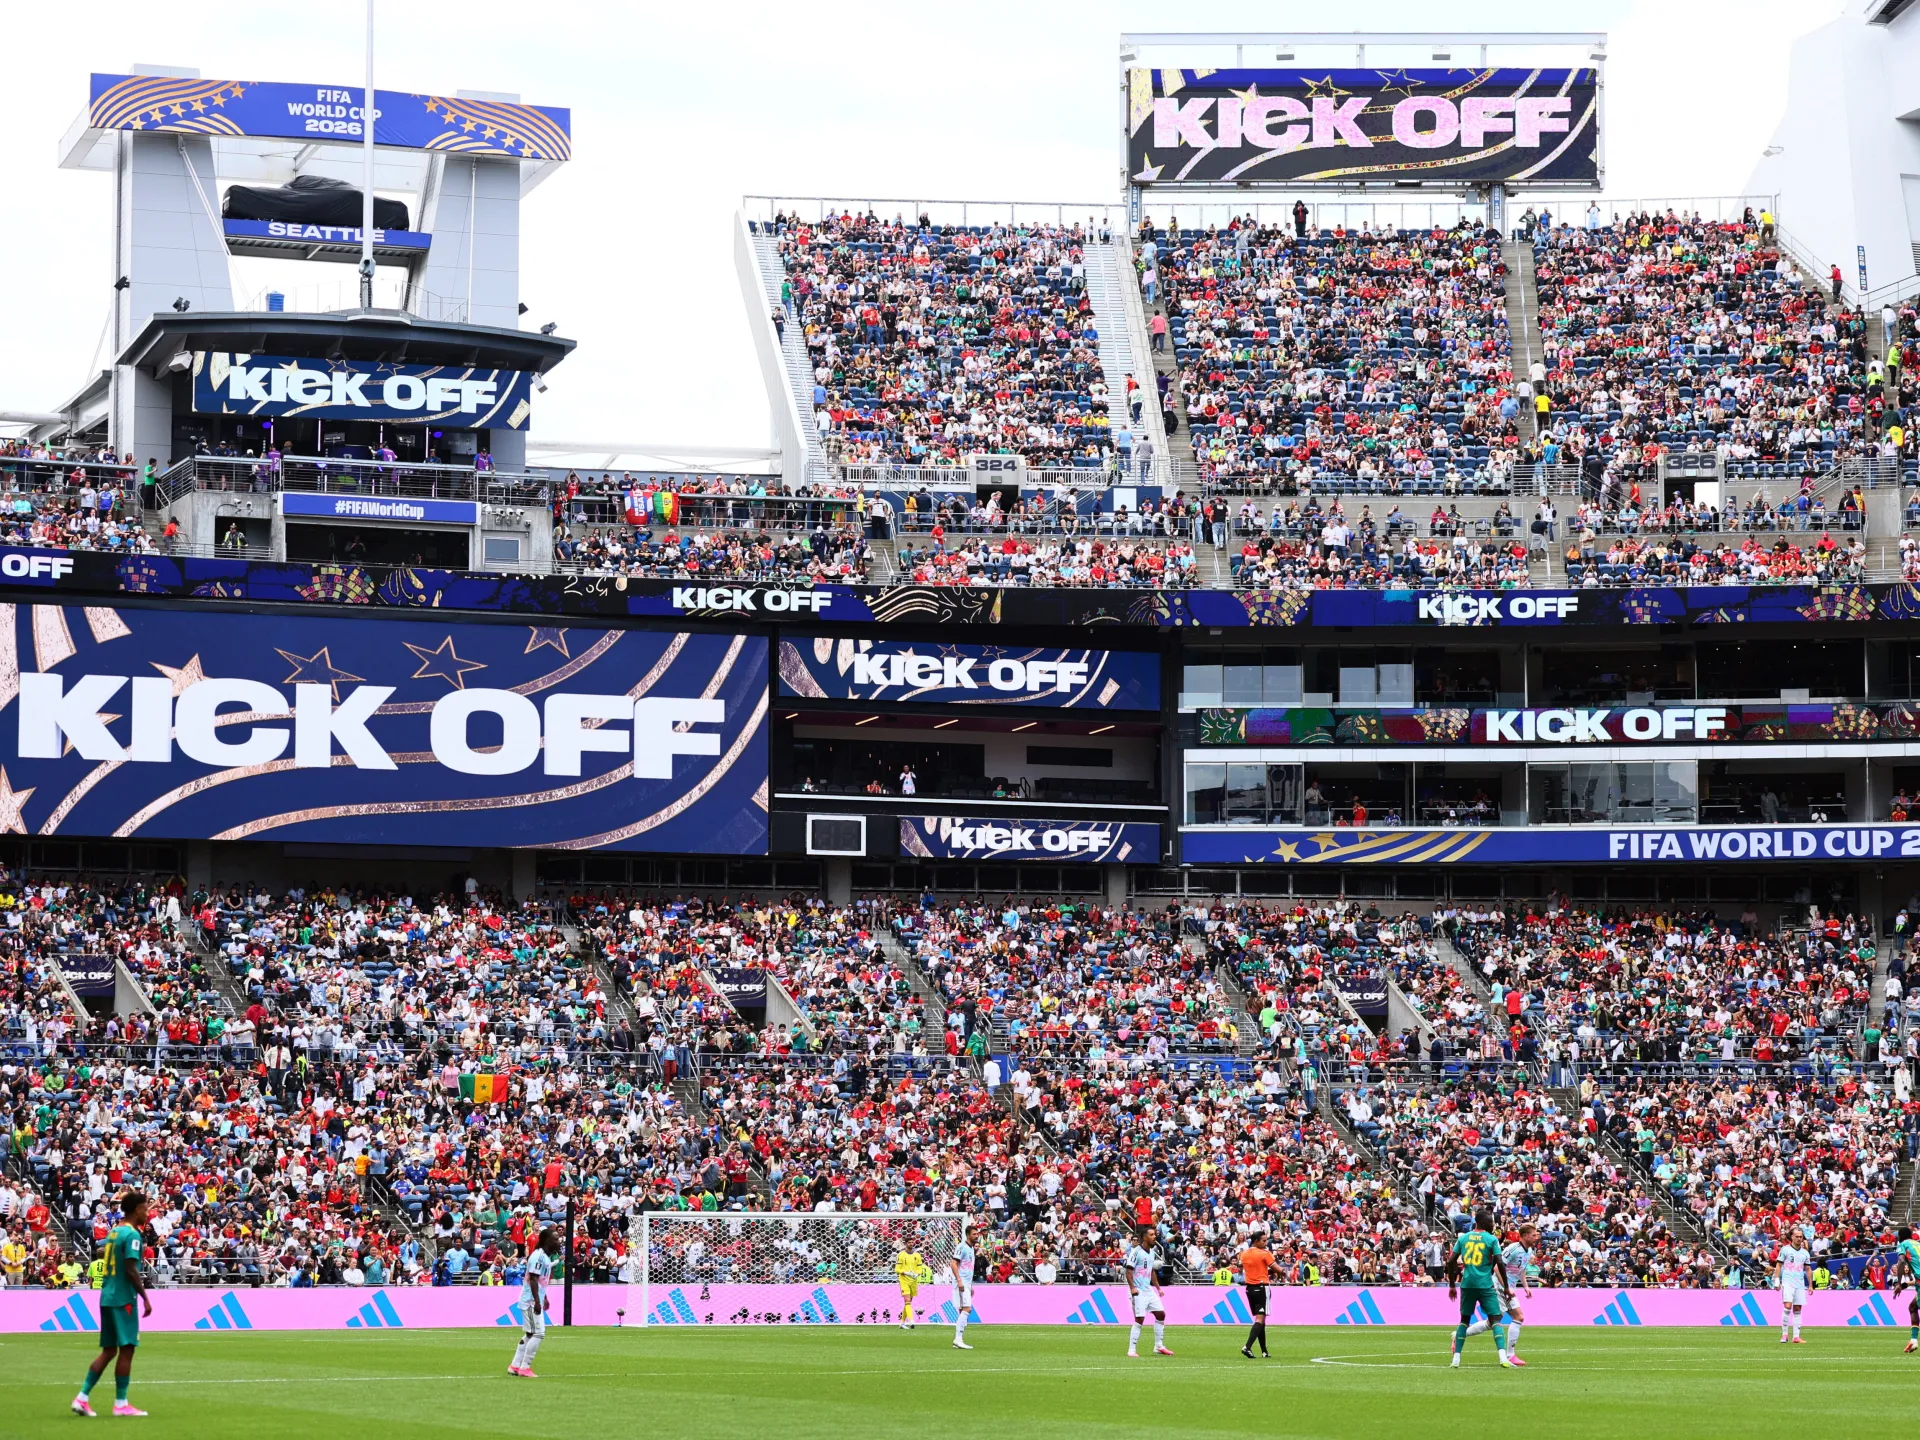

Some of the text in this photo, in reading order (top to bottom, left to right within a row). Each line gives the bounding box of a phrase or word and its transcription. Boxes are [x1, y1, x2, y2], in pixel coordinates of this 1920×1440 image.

[317, 89, 351, 103] FIFA
[287, 103, 346, 118] WORLD
[305, 119, 363, 135] 2026
[1154, 96, 1572, 148] KICK OFF
[268, 222, 385, 242] SEATTLE
[229, 366, 497, 414] KICK OFF
[975, 459, 1018, 471] 324
[1666, 454, 1716, 470] 326
[335, 500, 424, 520] #FIFAWorldCup
[1, 553, 74, 580] OFF
[673, 587, 832, 612] KICK OFF
[1418, 597, 1579, 619] KICK OFF
[854, 652, 1088, 693] KICK OFF
[18, 671, 725, 780] KICK OFF
[1486, 708, 1726, 741] KICK OFF
[951, 826, 1111, 852] KICK OFF
[1609, 833, 1684, 859] FIFA
[1689, 831, 1817, 859] WORLD
[1824, 830, 1894, 857] CUP
[88, 971, 112, 980] OFF
[741, 984, 763, 993] OFF
[1363, 992, 1385, 1001] OFF
[1463, 1241, 1486, 1267] 26
